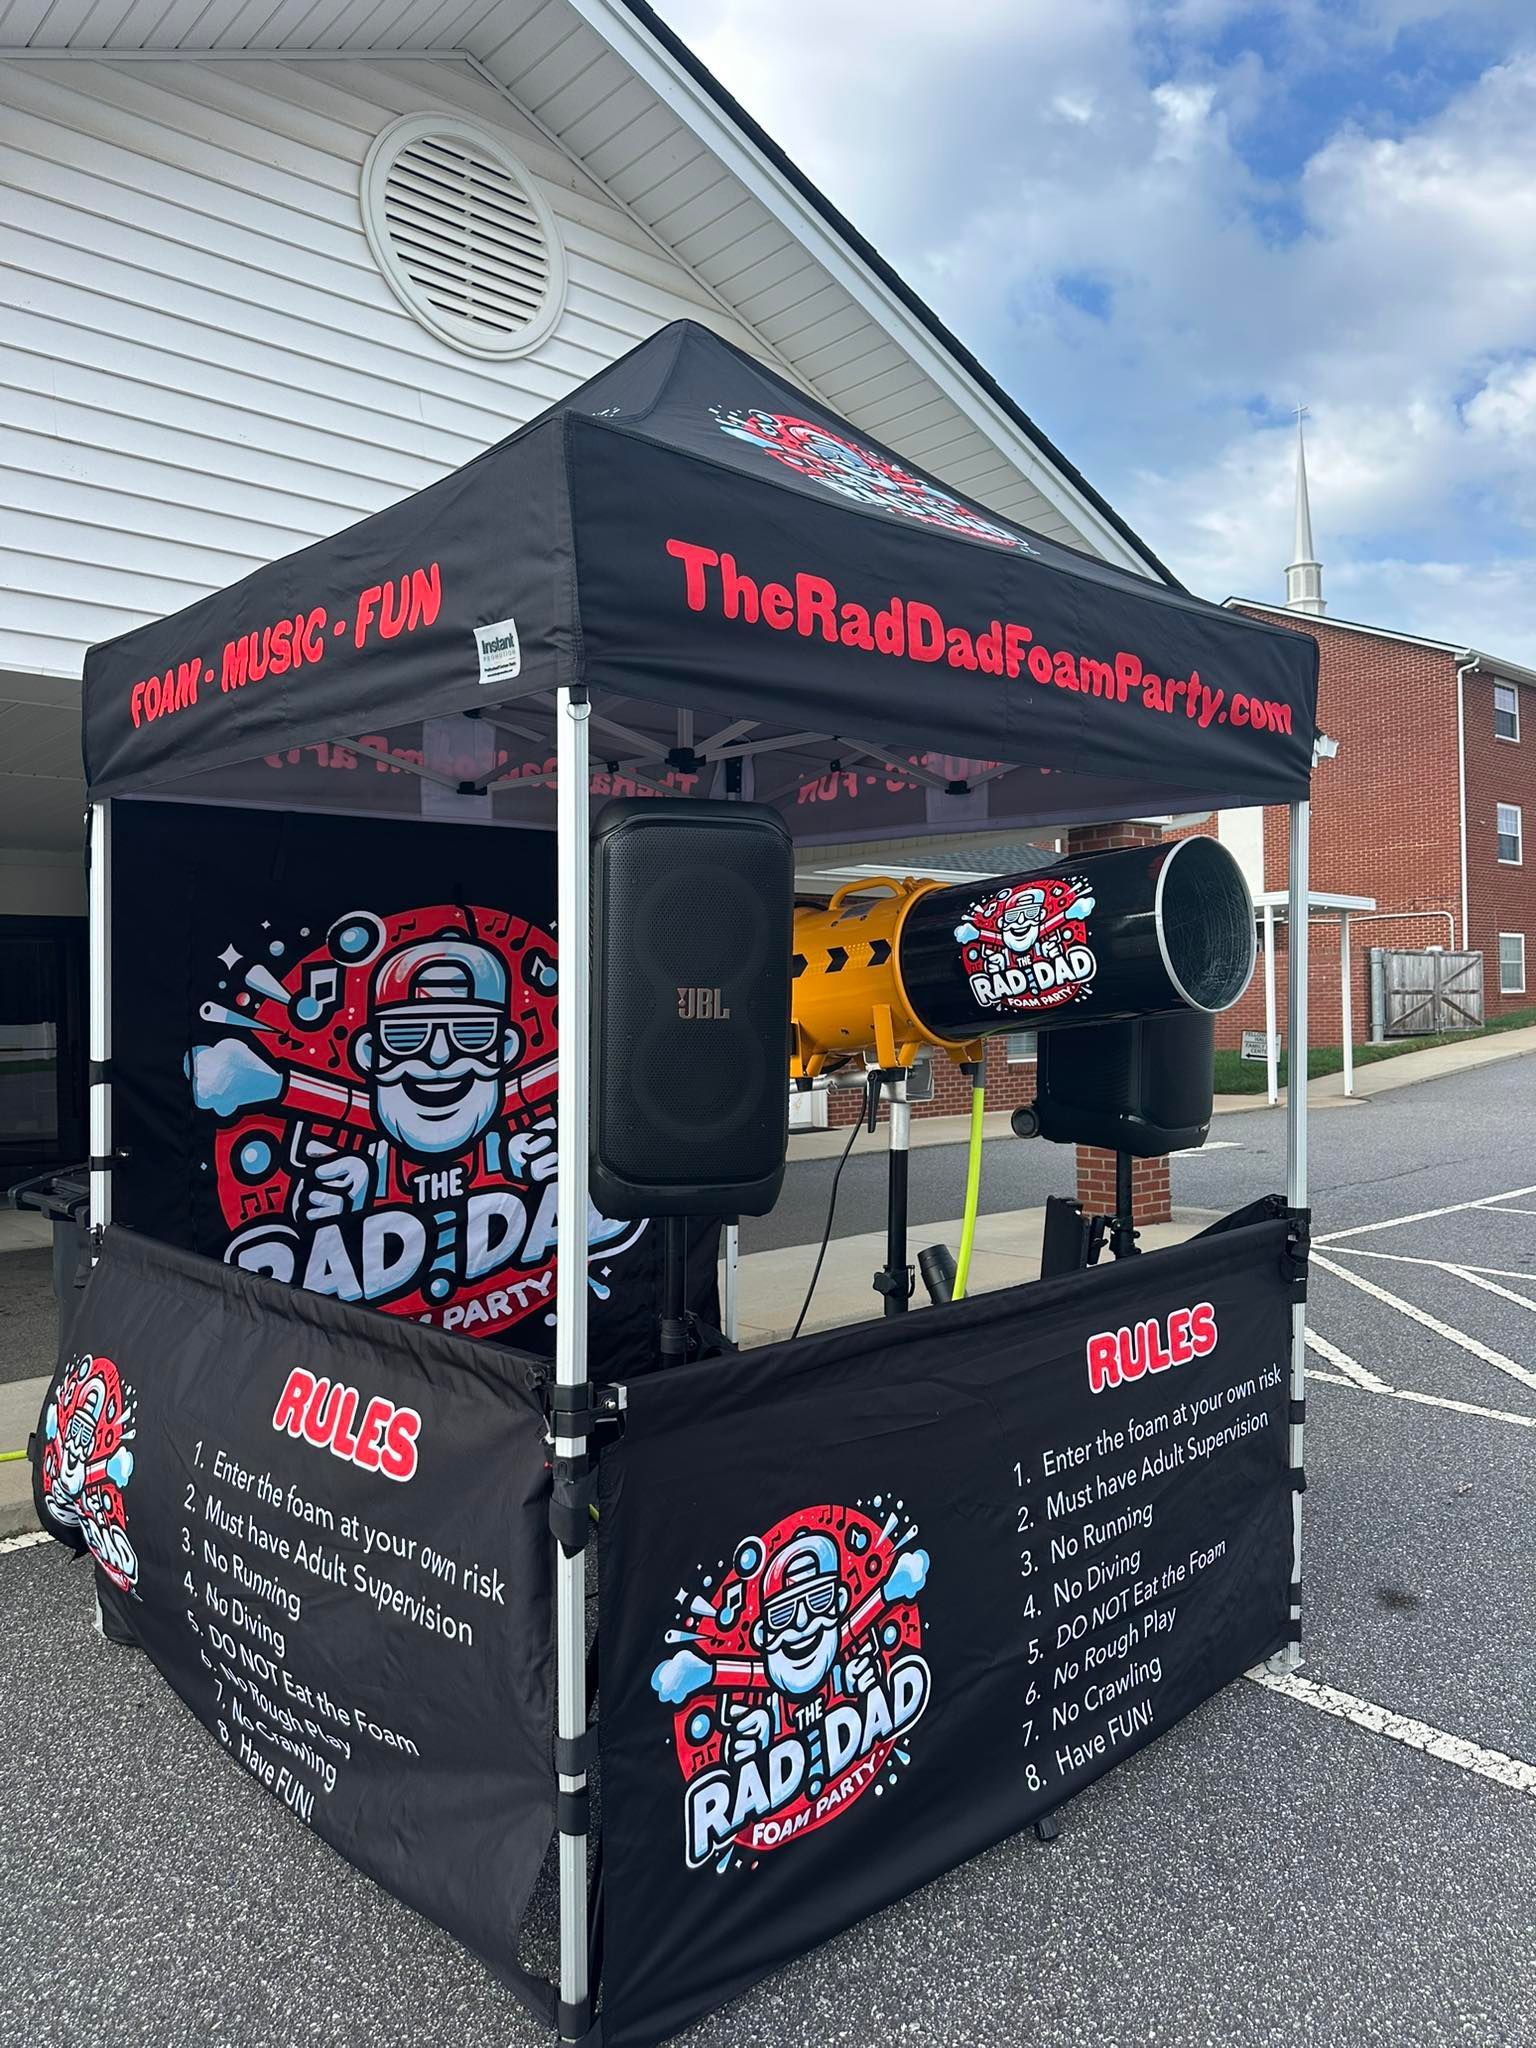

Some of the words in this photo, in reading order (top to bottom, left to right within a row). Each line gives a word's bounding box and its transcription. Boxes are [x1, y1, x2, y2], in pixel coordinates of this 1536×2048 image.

[131, 657, 202, 729] FOAM
[221, 607, 327, 693] MUSIC
[354, 562, 442, 649] FUN
[481, 632, 515, 655] Instant
[665, 537, 1293, 735] TheRadDadFoamParty.com
[677, 988, 730, 1019] JBL
[972, 968, 1027, 1004] RAD
[1033, 949, 1092, 990] DAD
[1007, 996, 1041, 1008] FOAM
[1043, 985, 1073, 1006] PARTY
[1016, 954, 1033, 968] THE
[413, 1167, 463, 1203] THE
[442, 1270, 554, 1331] PARTY
[1087, 1302, 1218, 1394] RULES
[272, 1366, 422, 1482] RULES
[1013, 1462, 1031, 1487] 1.
[1043, 1442, 1092, 1477] Enter
[1096, 1429, 1124, 1456] the
[1127, 1413, 1168, 1443] foam
[1173, 1403, 1188, 1427] at
[1190, 1391, 1223, 1426] your
[1227, 1379, 1256, 1404] own
[1258, 1363, 1282, 1391] risk
[1016, 1506, 1034, 1532] 2.
[1047, 1485, 1093, 1520] Must
[1097, 1468, 1137, 1499] have
[1141, 1446, 1184, 1481] Adult
[1188, 1411, 1269, 1461] Supervision
[184, 1483, 195, 1512] 2.
[205, 1495, 244, 1538] Must
[248, 1515, 290, 1559] have
[293, 1539, 347, 1586] Adult
[353, 1564, 472, 1646] Supervision
[194, 1440, 204, 1468] 1.
[213, 1450, 255, 1492] Enter
[257, 1472, 283, 1507] the
[287, 1485, 334, 1530] foam
[340, 1516, 359, 1541] at
[364, 1525, 417, 1560] your
[421, 1547, 456, 1585] own
[463, 1564, 505, 1605] risk
[1020, 1550, 1038, 1576] 3.
[1051, 1536, 1078, 1564] No
[1084, 1502, 1153, 1549] Running
[181, 1527, 195, 1555] 3.
[204, 1539, 228, 1572] No
[232, 1554, 300, 1621] Running
[183, 1571, 197, 1597] 4.
[206, 1582, 228, 1616] No
[232, 1598, 285, 1658] Diving
[1023, 1594, 1042, 1618] 4.
[1054, 1579, 1082, 1607] No
[1087, 1550, 1141, 1592] Diving
[1027, 1639, 1044, 1664] 5.
[1056, 1615, 1088, 1649] DO
[1092, 1589, 1130, 1629] NOT
[1133, 1578, 1158, 1606] Eat
[1162, 1564, 1185, 1590] the
[1189, 1539, 1226, 1575] Foam
[187, 1609, 204, 1636] 5.
[209, 1624, 236, 1659] DO
[239, 1643, 278, 1685] NOT
[282, 1670, 315, 1708] Eat
[316, 1691, 351, 1726] the
[354, 1708, 420, 1757] Foam
[1022, 1720, 1039, 1747] 7.
[1052, 1702, 1079, 1730] No
[1084, 1656, 1161, 1711] Crawling
[1025, 1681, 1041, 1705] 6.
[1053, 1662, 1078, 1689] No
[1084, 1624, 1139, 1672] Rough
[1144, 1607, 1176, 1638] Play
[201, 1649, 217, 1671] 6.
[220, 1663, 248, 1692] No
[248, 1680, 304, 1733] Rough
[304, 1719, 351, 1759] Play
[214, 1678, 226, 1709] 7.
[232, 1696, 254, 1731] No
[256, 1721, 337, 1792] Crawling
[795, 1698, 823, 1731] THE
[1025, 1763, 1047, 1791] 8.
[1055, 1735, 1106, 1775] Have
[1107, 1699, 1153, 1745] FUN!
[217, 1719, 233, 1747] 8.
[240, 1733, 275, 1785] Have
[275, 1766, 315, 1824] FUN!
[693, 1739, 806, 1859] RAD
[824, 1665, 924, 1777] DAD
[752, 1808, 811, 1847] FOAM
[815, 1752, 877, 1819] PARTY
